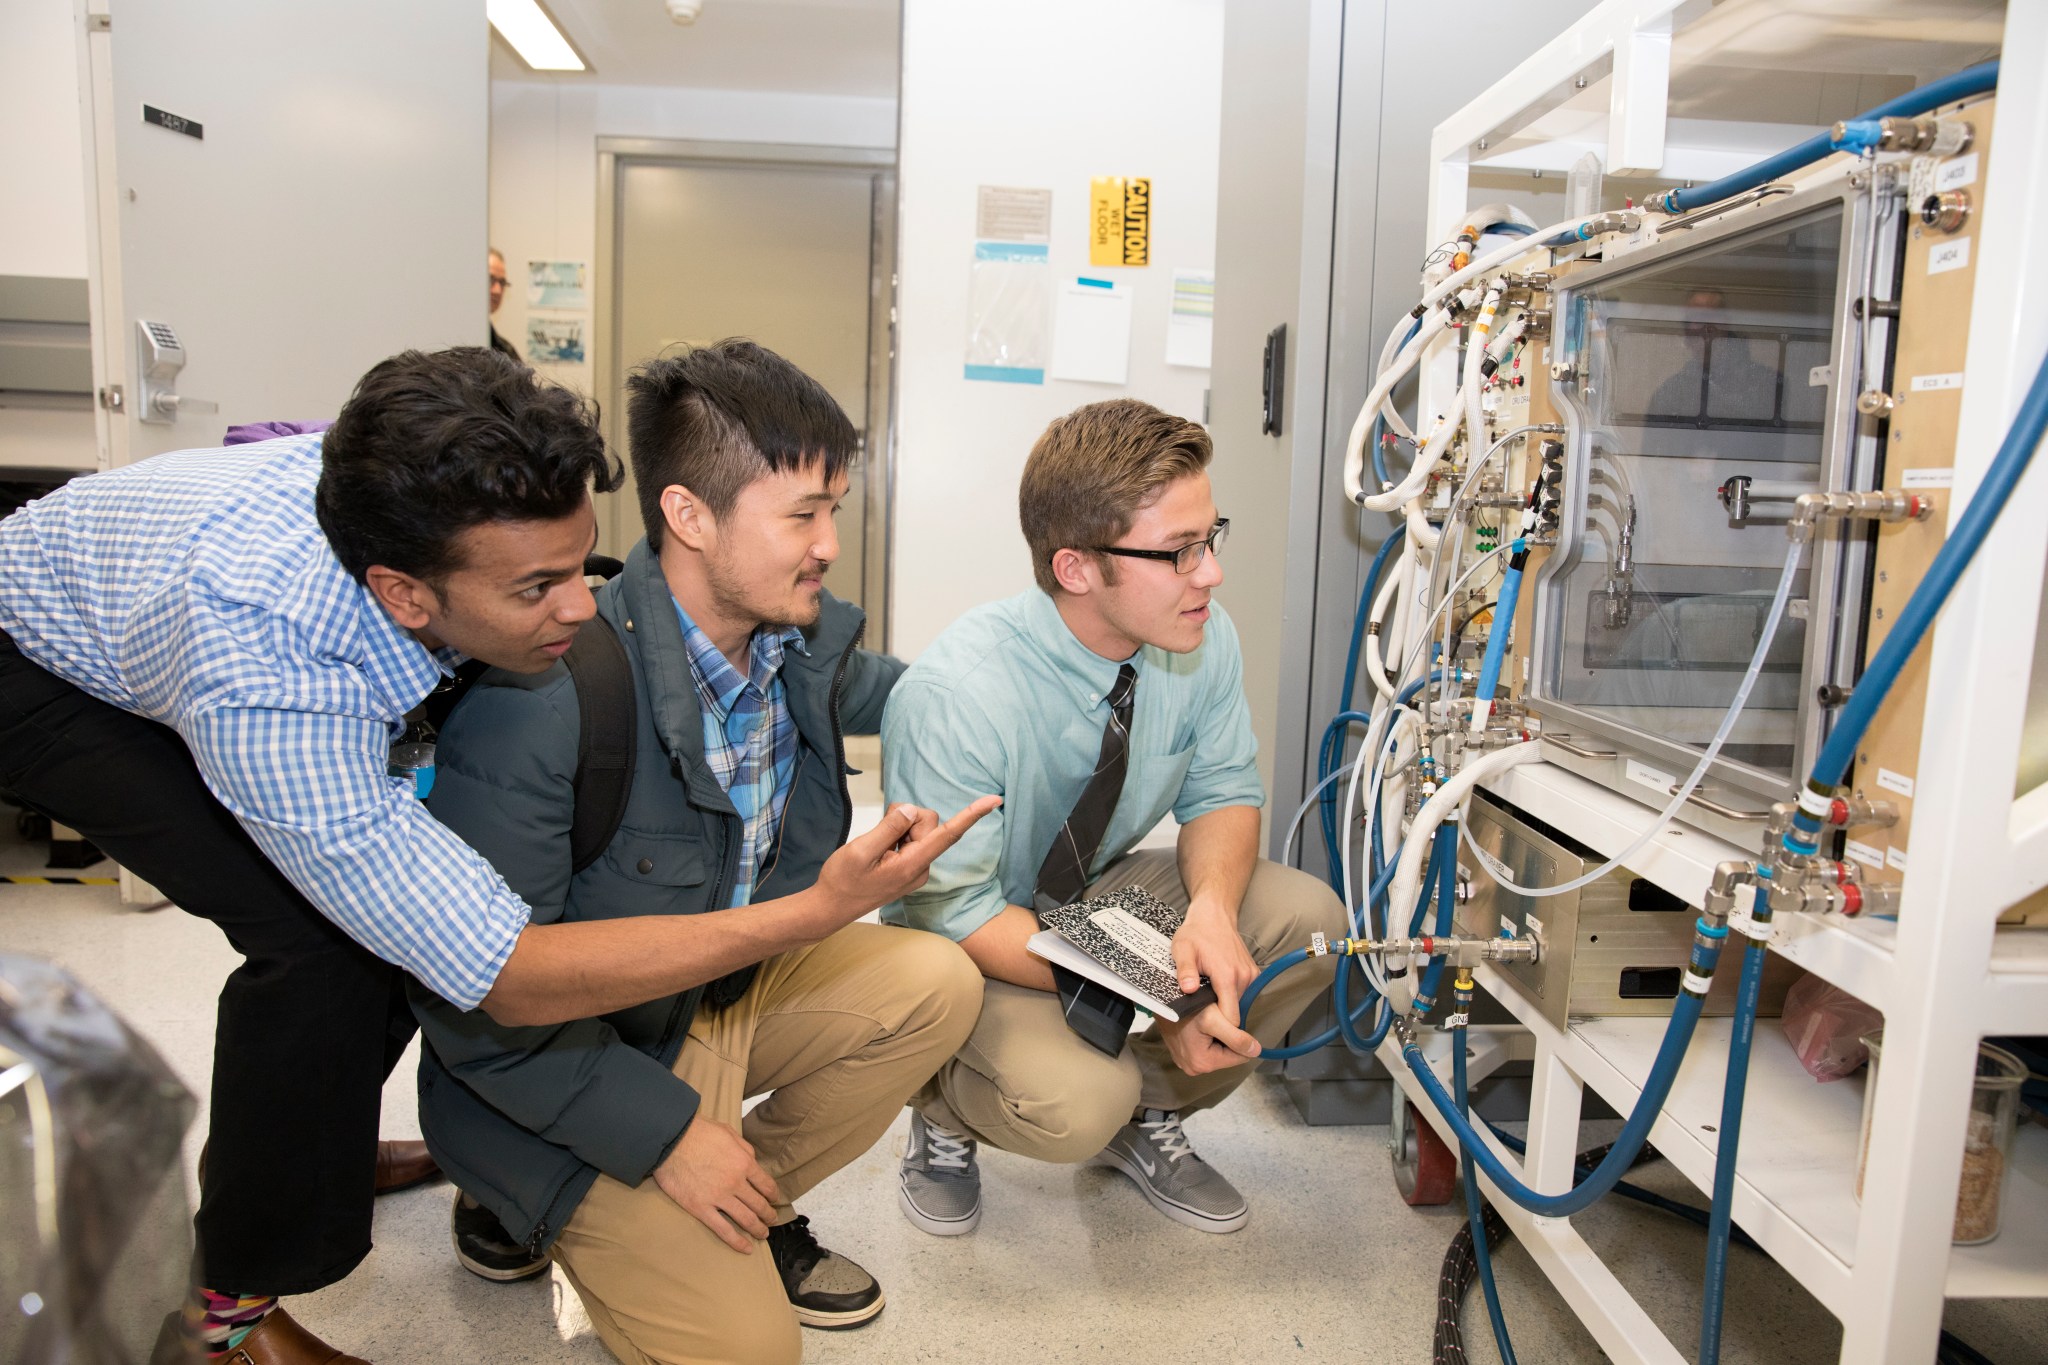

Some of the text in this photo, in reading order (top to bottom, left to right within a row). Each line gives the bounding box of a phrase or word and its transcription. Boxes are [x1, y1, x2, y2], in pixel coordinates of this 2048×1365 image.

[160, 112, 189, 133] 1487
[1097, 199, 1109, 246] FLOOR
[1111, 208, 1121, 239] WET
[1125, 178, 1150, 265] CAUTION
[1452, 1015, 1469, 1024] GN2
